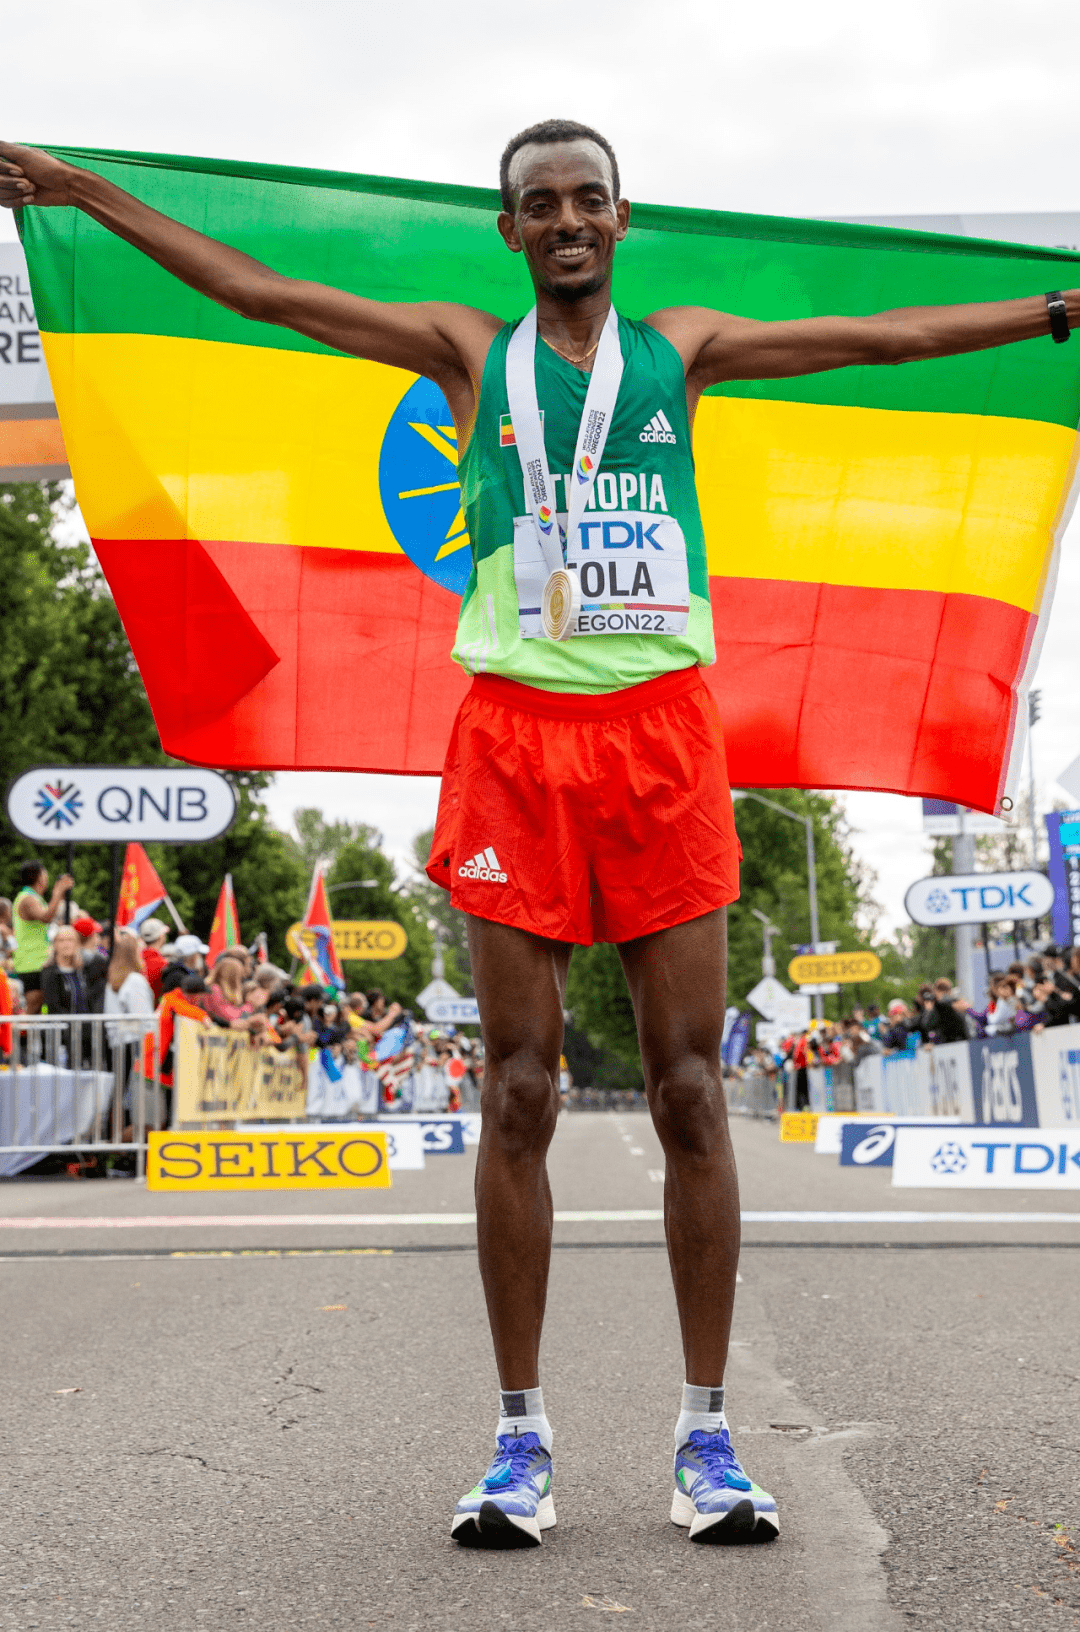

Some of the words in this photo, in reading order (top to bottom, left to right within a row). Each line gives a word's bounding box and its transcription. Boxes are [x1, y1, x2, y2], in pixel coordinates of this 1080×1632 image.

[639, 431, 677, 445] adidas
[578, 521, 664, 550] TDK
[567, 561, 656, 598] OLA
[573, 614, 666, 632] EGON22
[97, 785, 208, 823] QNB
[458, 865, 508, 883] adidas
[951, 883, 1033, 911] TDK
[159, 1140, 384, 1179] SEIKO
